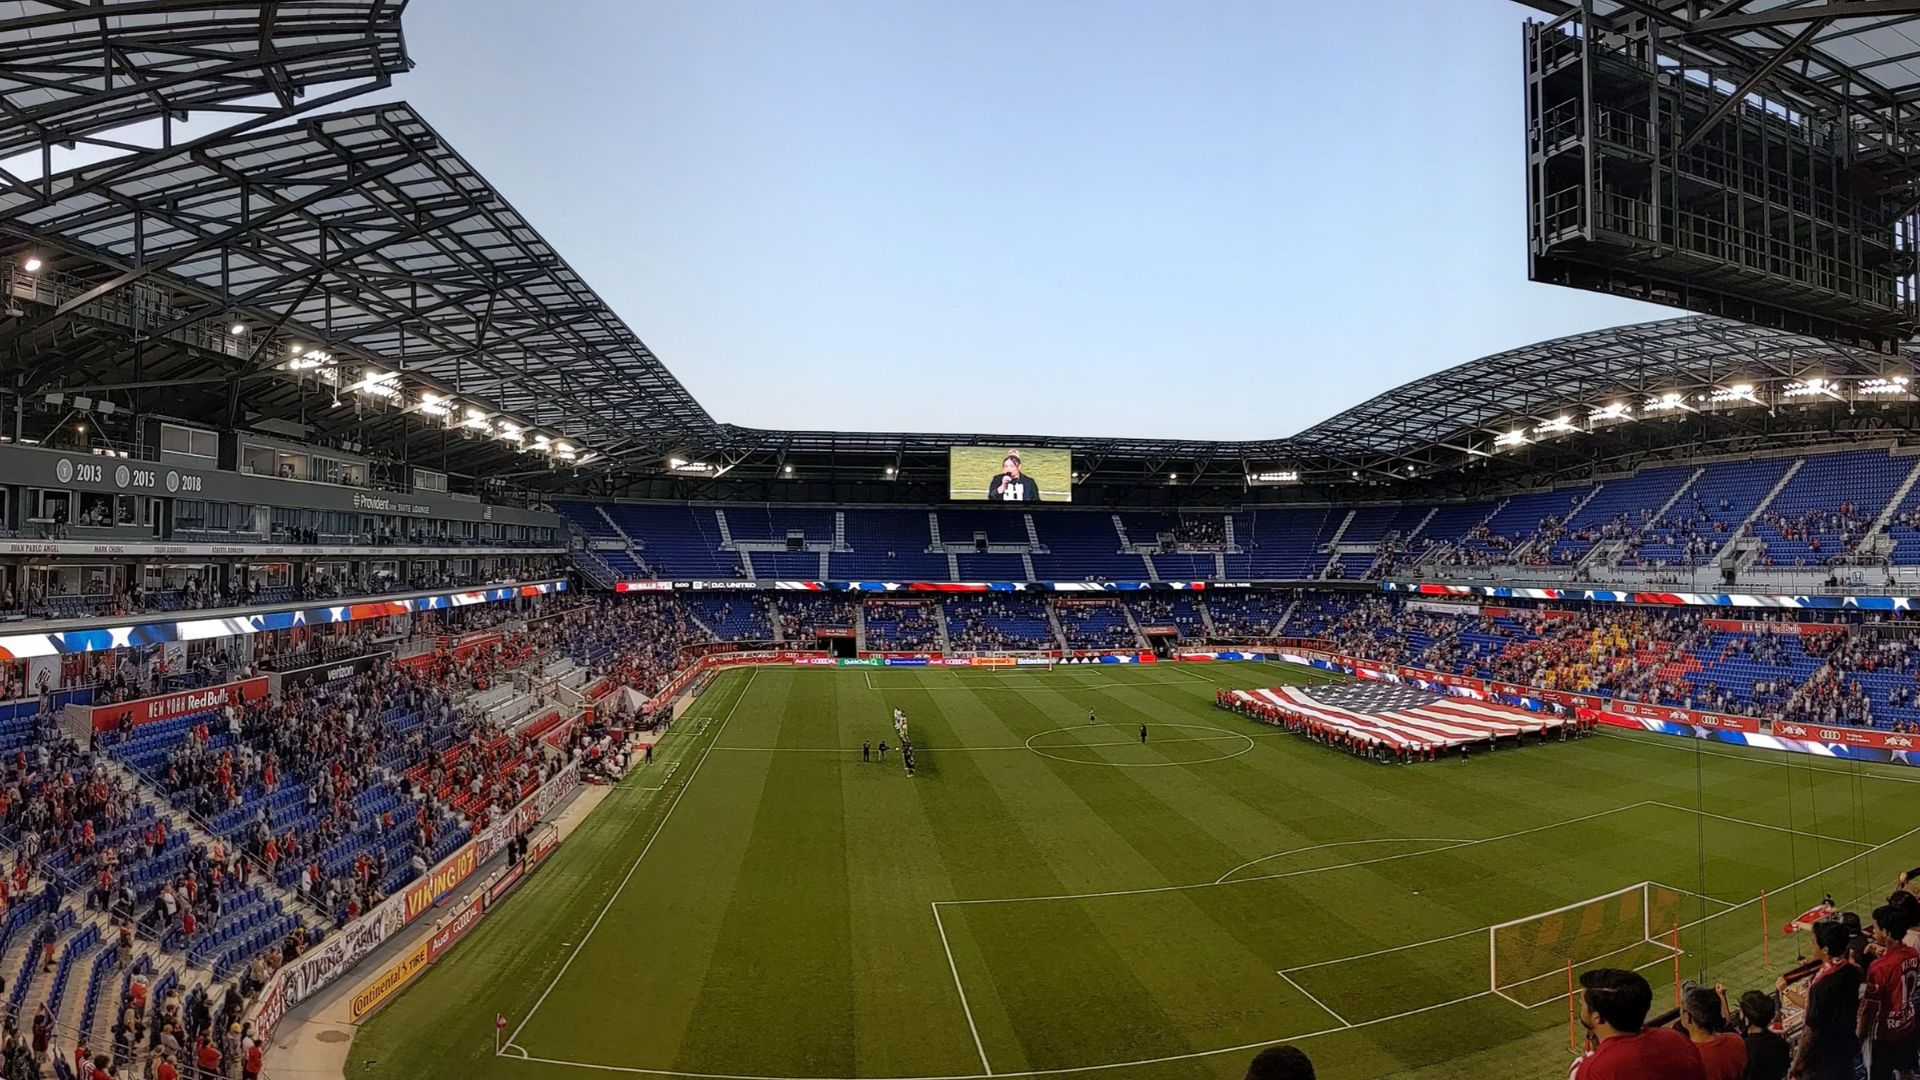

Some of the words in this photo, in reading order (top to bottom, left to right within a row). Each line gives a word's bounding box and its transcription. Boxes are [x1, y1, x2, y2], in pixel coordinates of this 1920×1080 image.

[77, 463, 102, 482] 2013
[133, 470, 155, 488] 2015
[181, 475, 202, 492] 2018
[360, 494, 389, 511] Provident
[397, 503, 411, 513] SUITE
[412, 505, 430, 514] LOUNGE
[10, 544, 25, 552] JUAN
[25, 544, 42, 552] PABLO
[43, 544, 59, 552] ANGEL
[94, 545, 108, 553] MARK
[109, 545, 124, 553] CHUNG
[327, 665, 354, 680] verizon
[148, 700, 165, 718] NEW
[166, 697, 186, 716] YORK
[407, 866, 456, 916] VIKING
[457, 848, 474, 881] 107
[432, 929, 450, 952] Audi
[300, 949, 344, 997] VIKING
[353, 967, 401, 1017] Continental
[409, 950, 425, 970] TIRE
